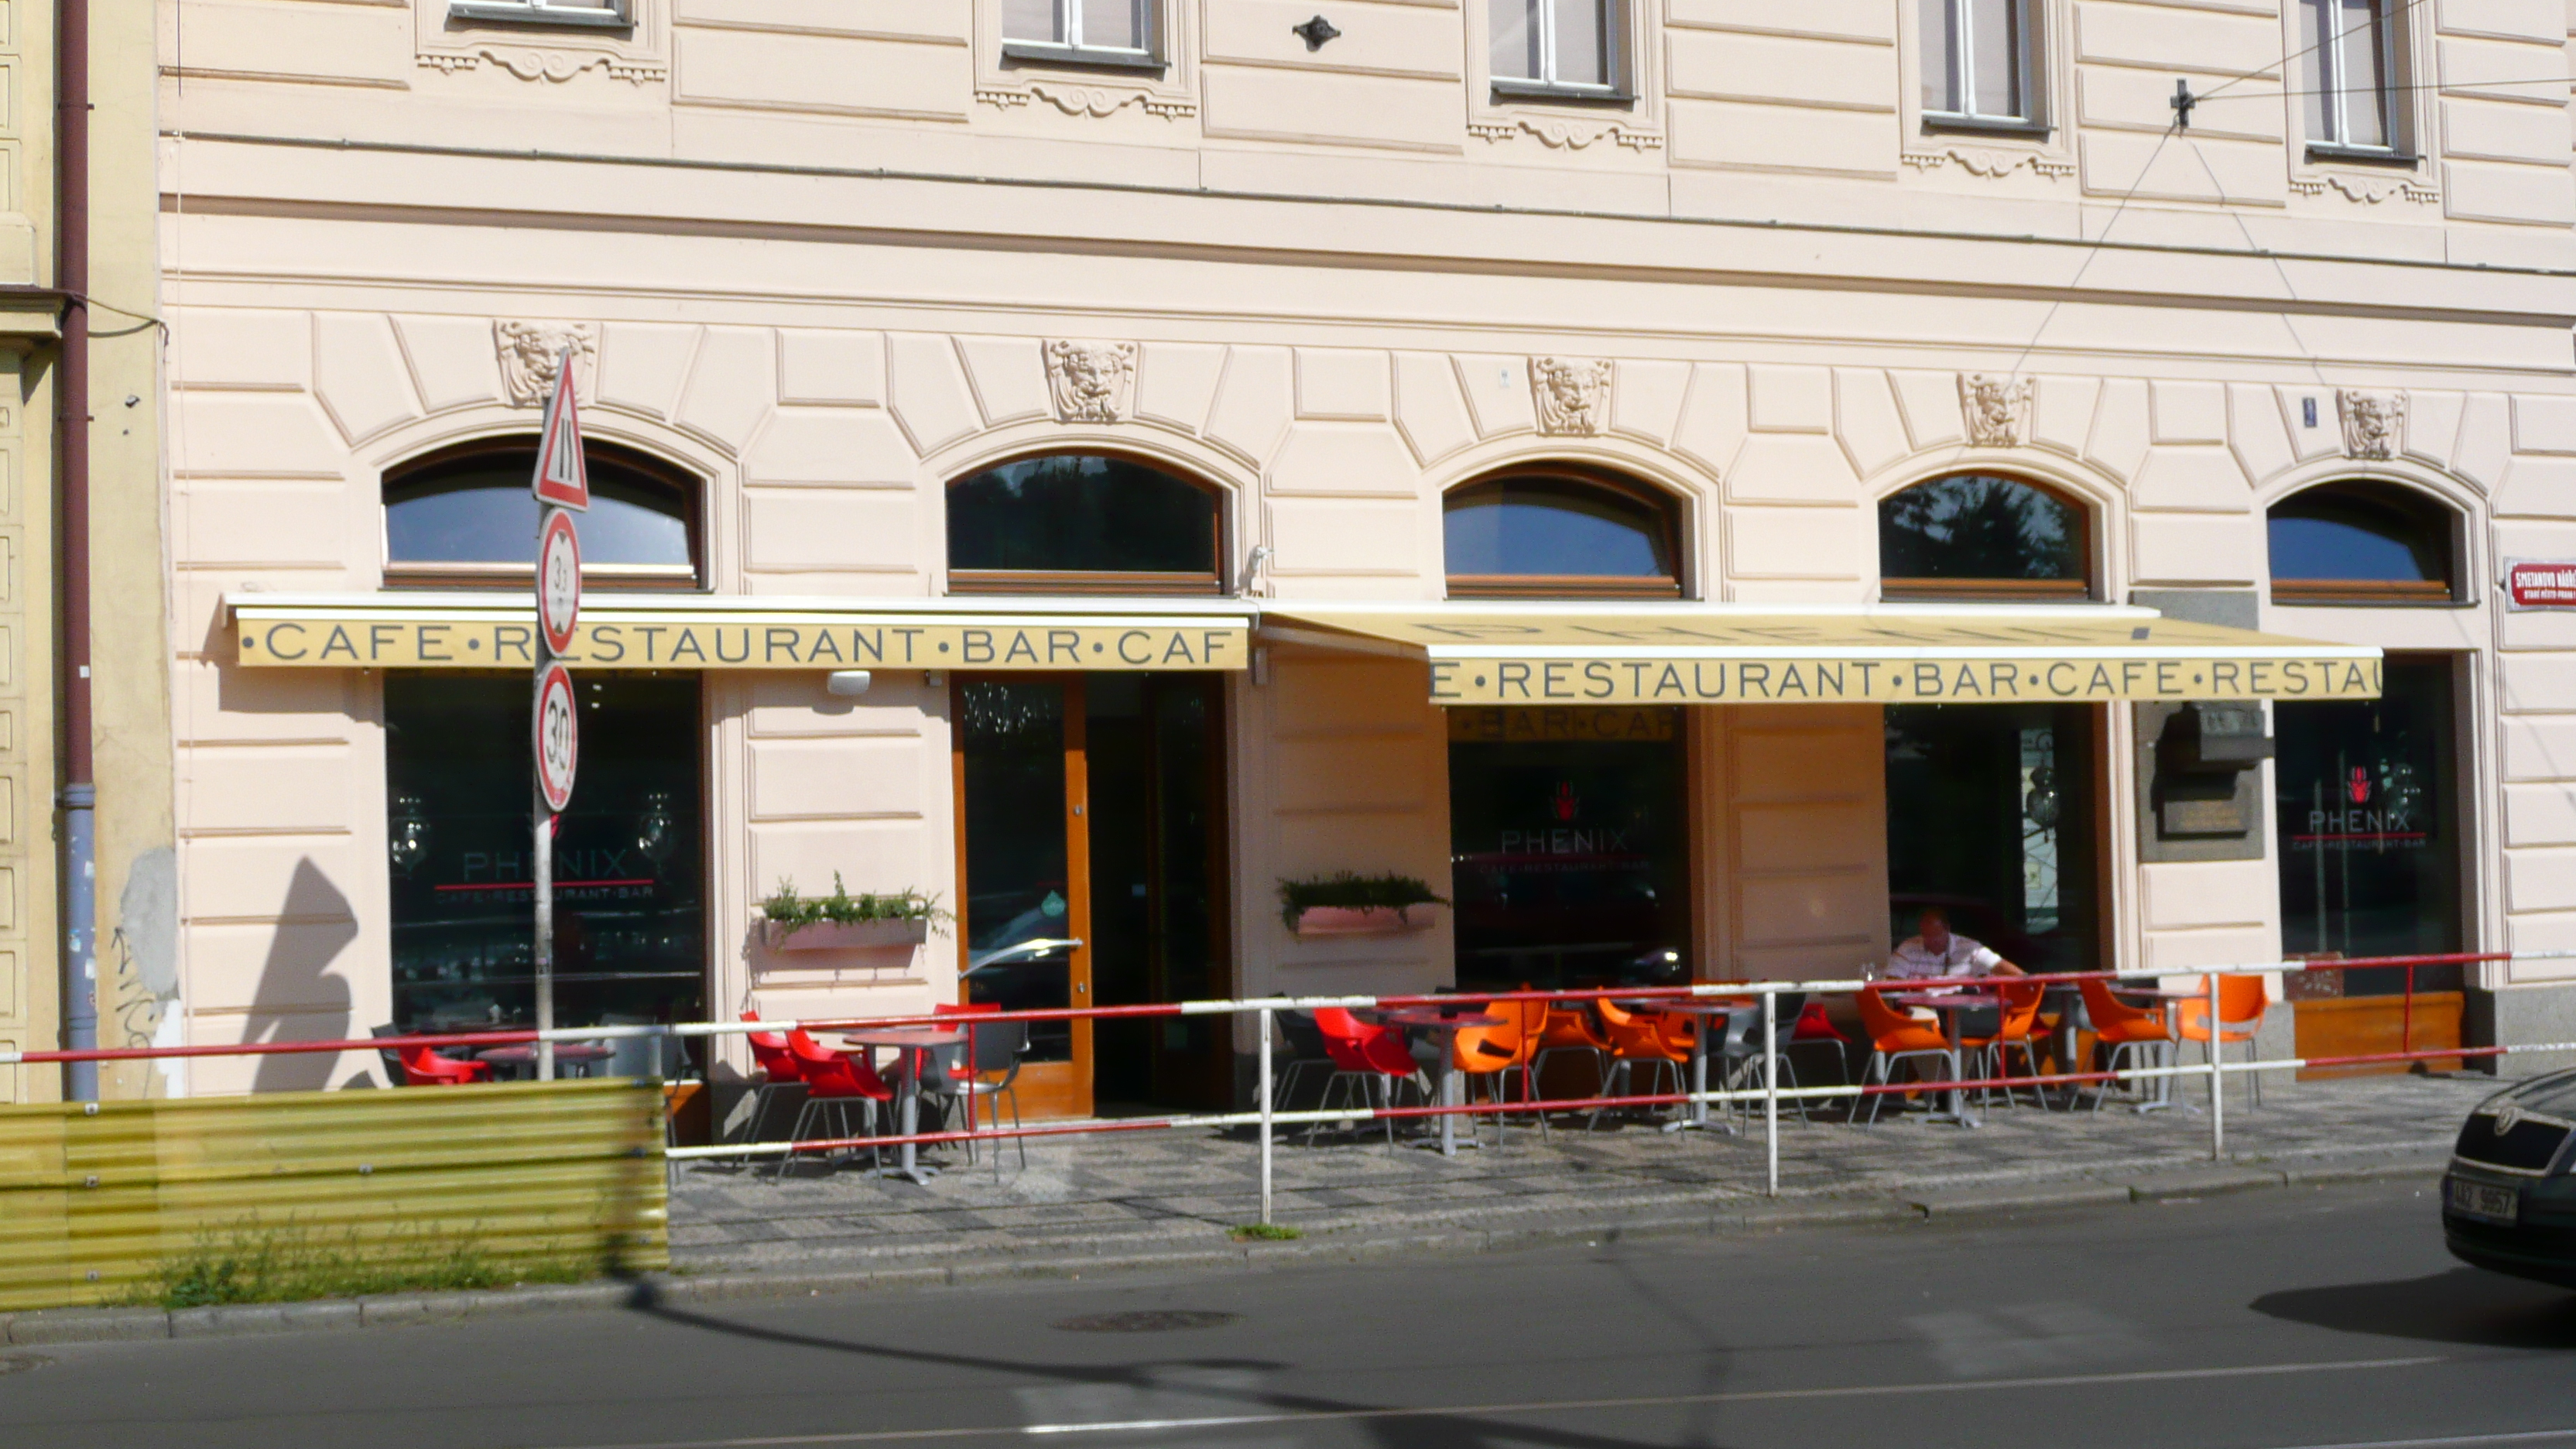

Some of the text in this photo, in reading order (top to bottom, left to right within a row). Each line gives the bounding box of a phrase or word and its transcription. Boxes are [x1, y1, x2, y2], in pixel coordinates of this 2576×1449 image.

[266, 624, 1233, 665] CAFE RSTAURANT BAR CAF
[1499, 662, 1880, 698] RESTAURANT
[1913, 663, 2018, 697] BAR
[2047, 662, 2184, 696] CAFE
[546, 699, 569, 770] 30
[2307, 809, 2410, 834] PHENIX
[1500, 828, 1628, 855] PHENIX
[492, 887, 609, 903] RESURANT
[618, 886, 653, 899] BAR
